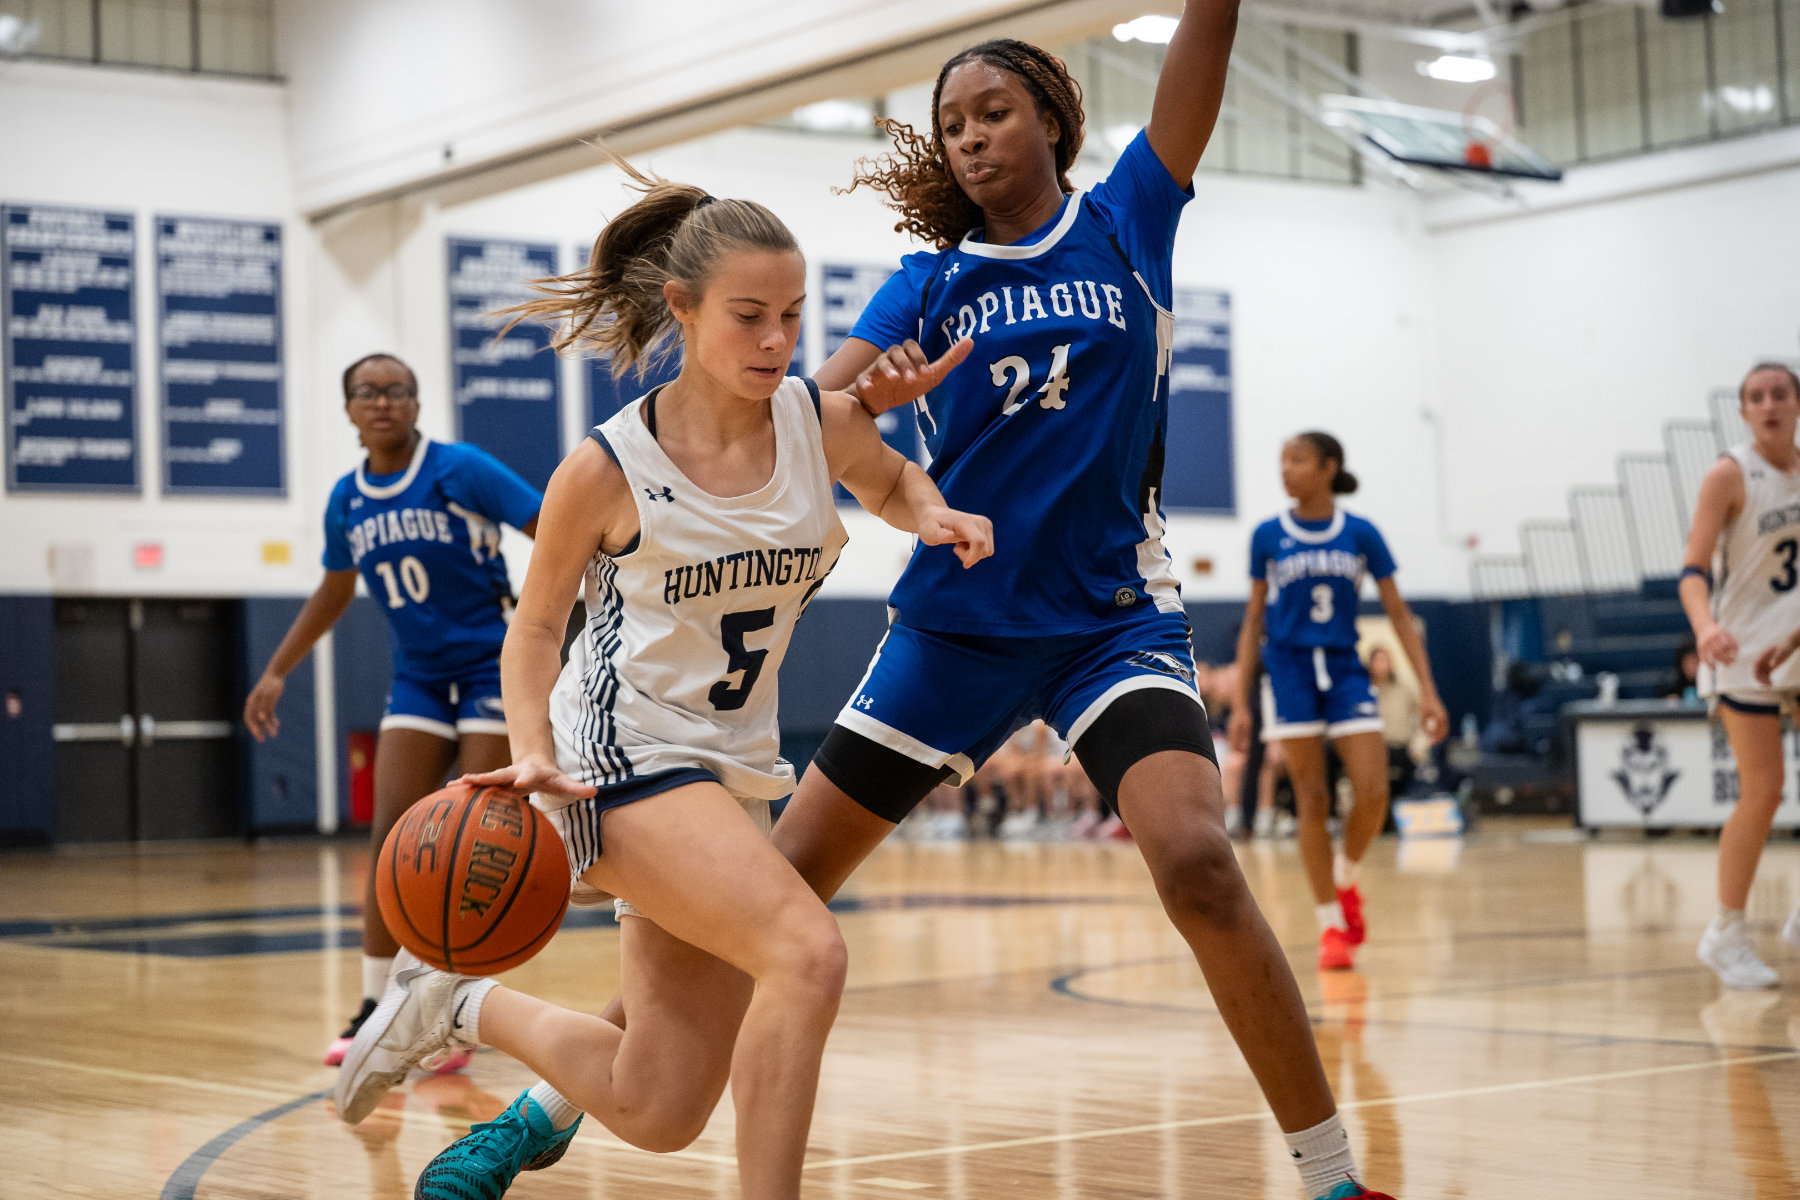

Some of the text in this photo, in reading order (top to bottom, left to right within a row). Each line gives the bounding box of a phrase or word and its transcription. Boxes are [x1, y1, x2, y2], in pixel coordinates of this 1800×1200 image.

[989, 343, 1071, 417] 24
[375, 556, 430, 609] 10
[664, 547, 824, 605] HUNTINGTO
[1770, 538, 1798, 593] 3
[1310, 583, 1334, 624] 3
[708, 605, 776, 711] 5
[460, 839, 519, 918] ROCK
